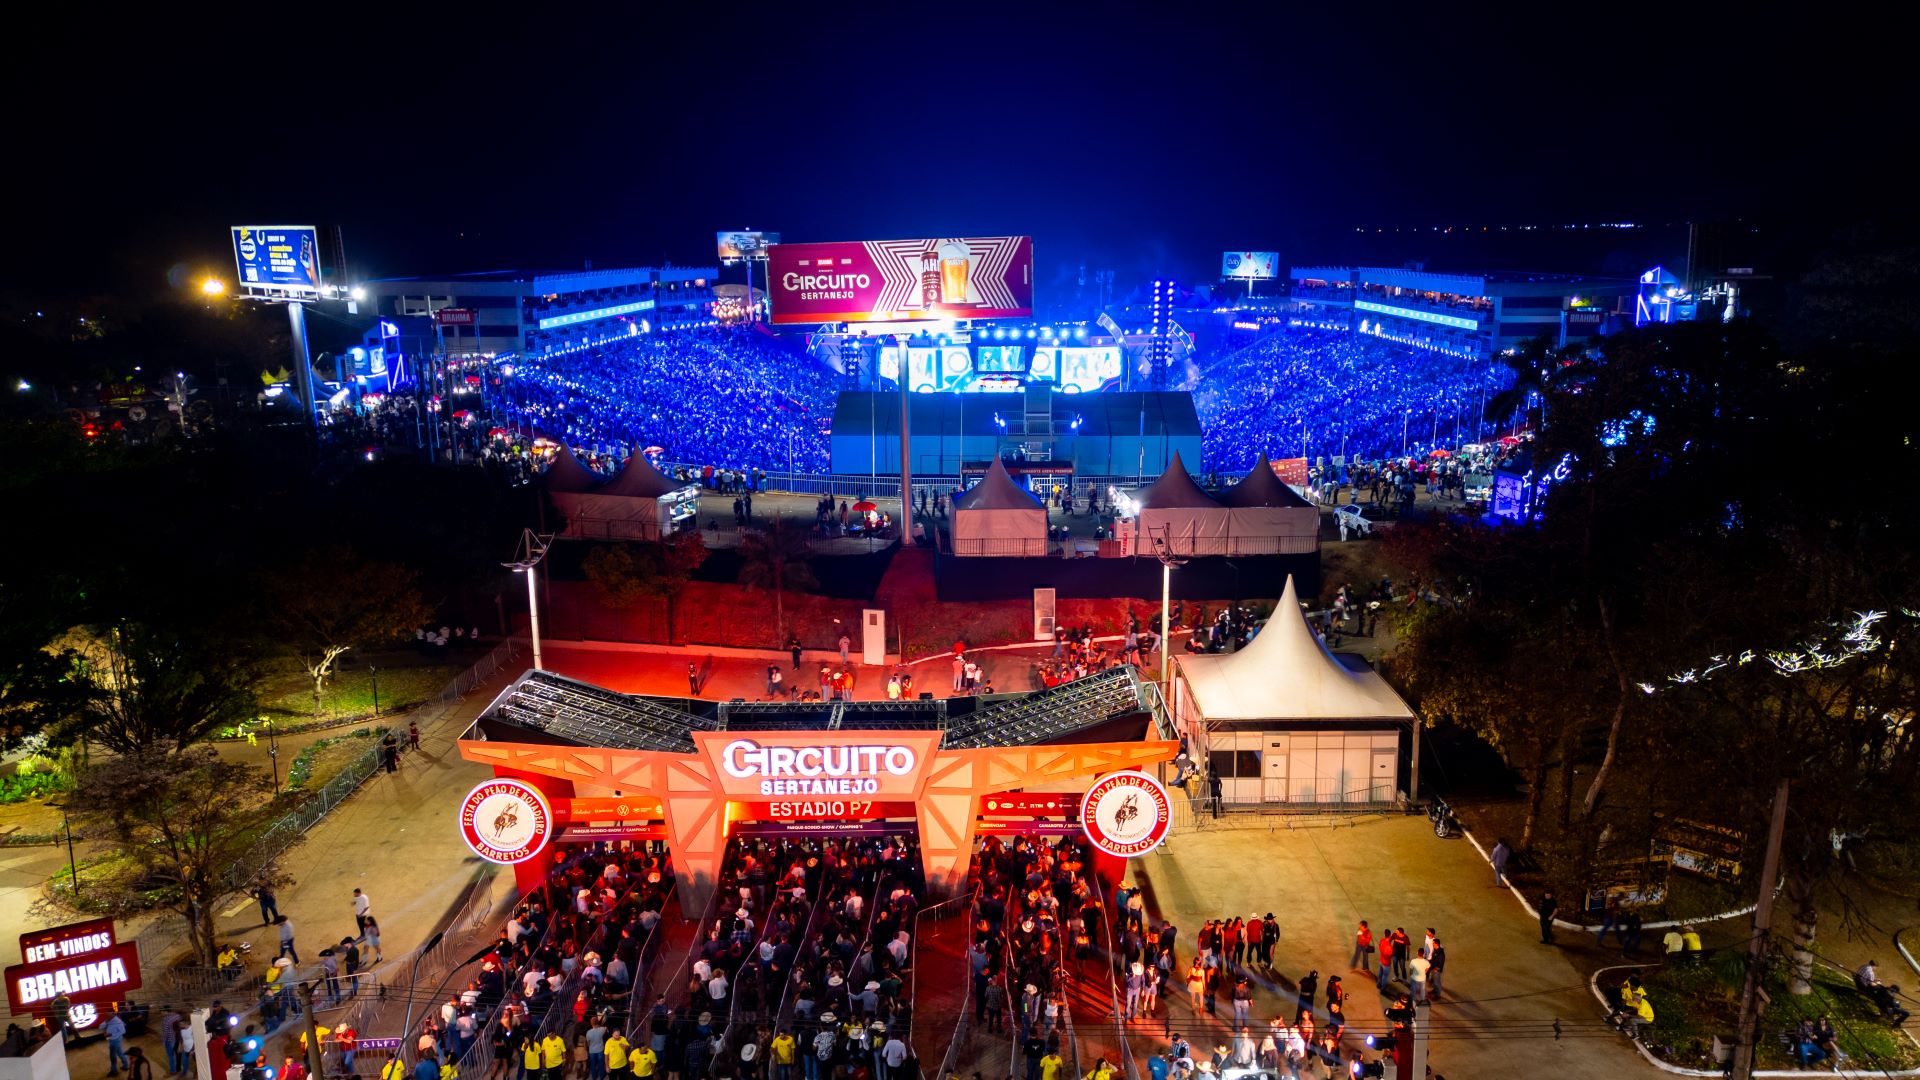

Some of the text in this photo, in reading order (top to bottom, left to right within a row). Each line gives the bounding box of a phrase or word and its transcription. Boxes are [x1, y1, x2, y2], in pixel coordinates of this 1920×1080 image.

[783, 272, 870, 291] CIRCUITO
[801, 291, 854, 300] SERTANEJO
[442, 313, 471, 321] BRAHMA
[1570, 314, 1600, 323] BRAHMA
[723, 740, 915, 778] CIRCUITO
[761, 779, 878, 796] SERTANEJO
[769, 801, 872, 817] ESTADIO P7
[1087, 800, 1097, 823] FESTA
[1093, 788, 1105, 800] DO
[1129, 777, 1141, 787] DE
[1141, 781, 1167, 822] BOIADEIRO
[464, 803, 476, 826] FESTA
[472, 793, 484, 804] DO
[509, 786, 520, 797] DE
[521, 792, 544, 835] BOIADEIRO
[476, 842, 530, 861] BARRETOS
[1100, 836, 1154, 853] BARRETOS
[26, 932, 112, 964] BEM-VINDOS
[18, 958, 128, 1004] BRAHMA
